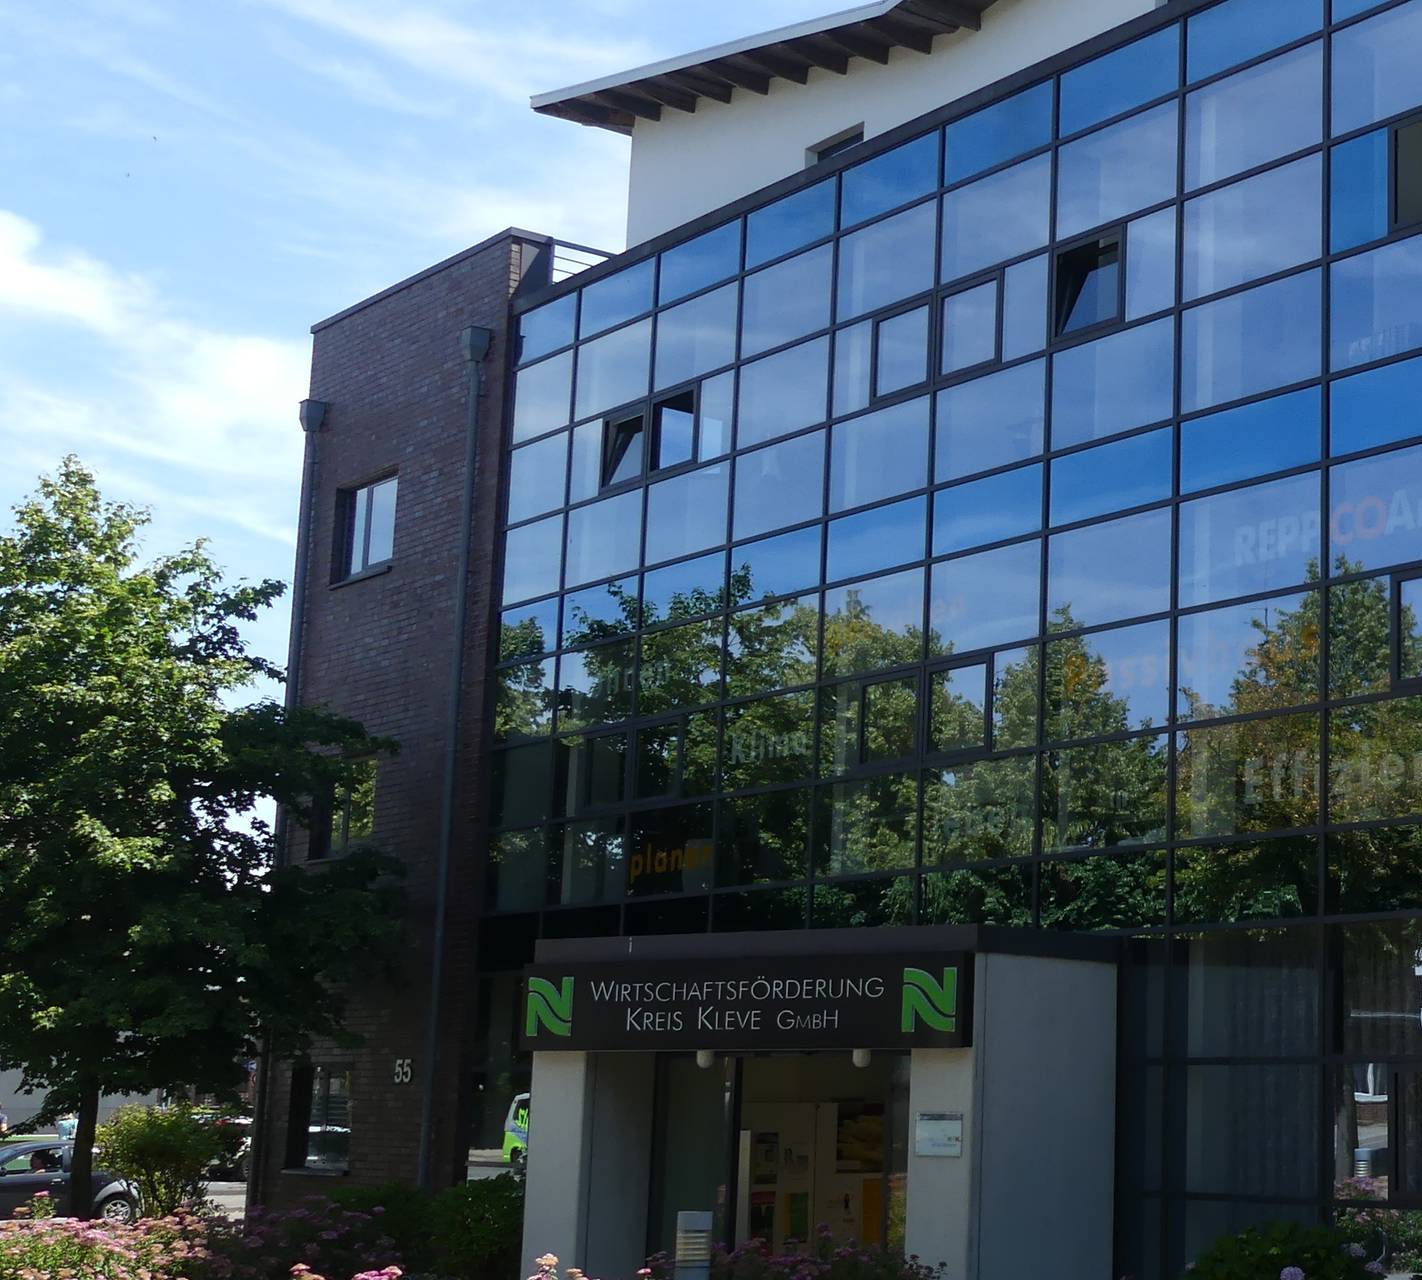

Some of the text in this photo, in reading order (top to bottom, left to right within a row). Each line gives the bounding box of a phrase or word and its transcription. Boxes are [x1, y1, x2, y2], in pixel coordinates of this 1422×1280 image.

[590, 975, 885, 1002] WIRTSCHAFTSFÖRDERUNG
[626, 1007, 683, 1031] KREIS
[698, 1006, 761, 1030] KLEVE
[394, 1058, 412, 1083] 55
